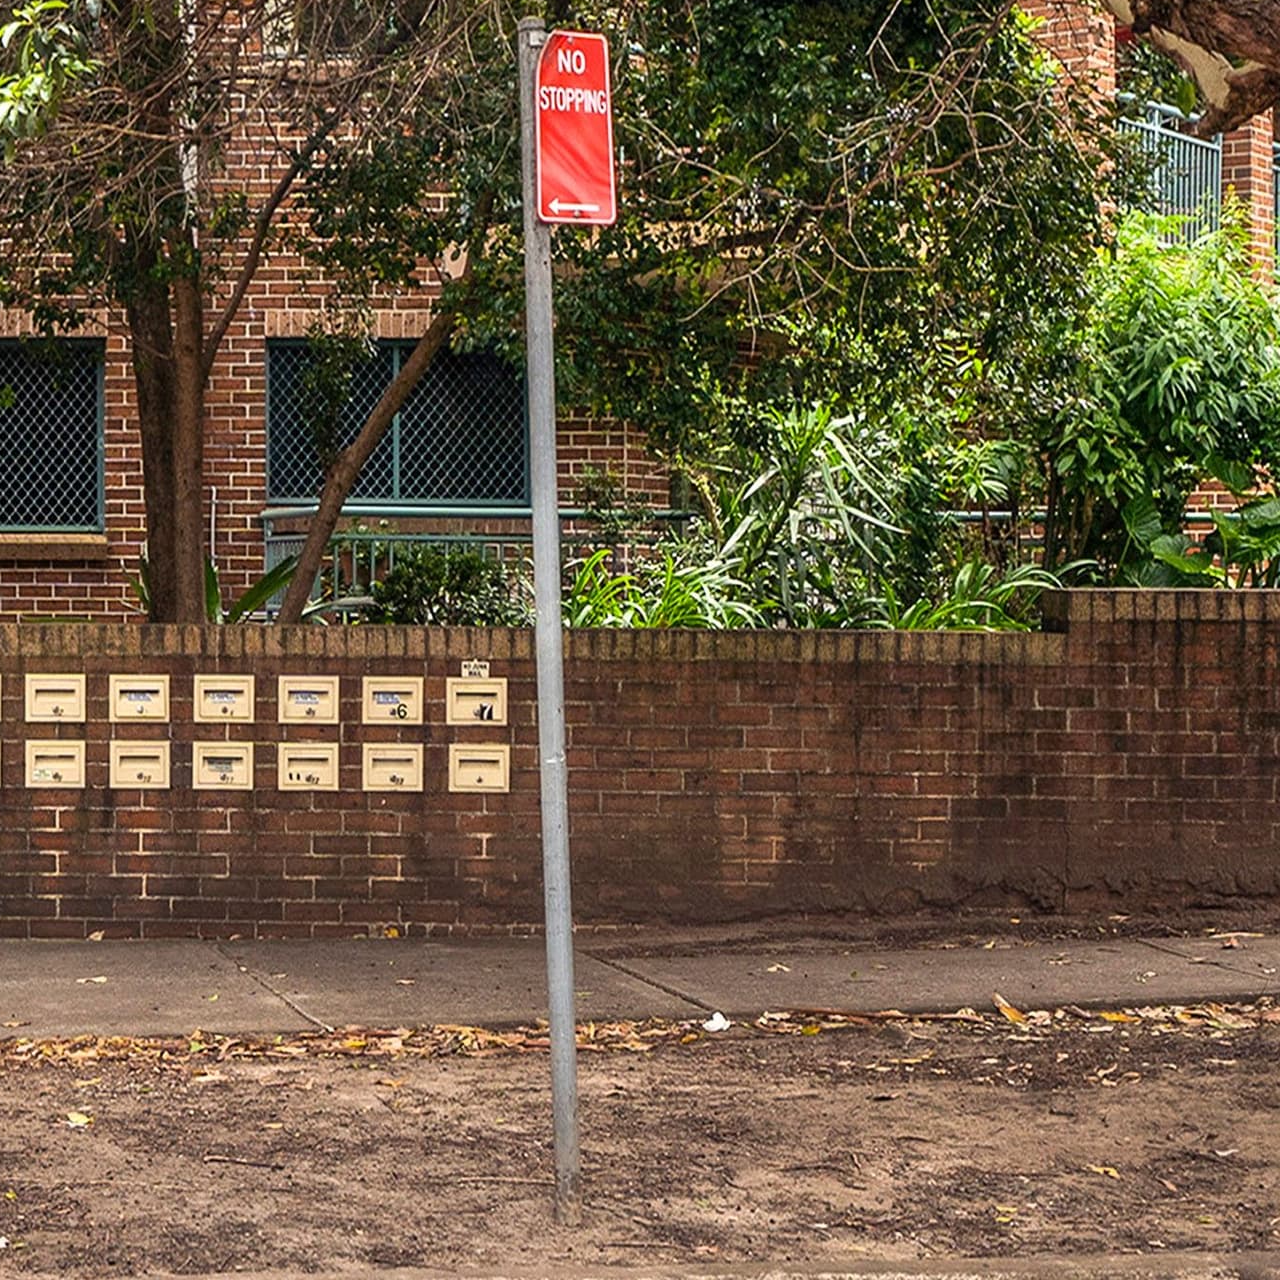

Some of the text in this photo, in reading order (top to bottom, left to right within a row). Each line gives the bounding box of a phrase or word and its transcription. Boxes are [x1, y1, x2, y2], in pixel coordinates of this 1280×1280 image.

[557, 49, 586, 75] NO
[540, 86, 607, 115] STOPPING
[397, 703, 408, 719] 6
[482, 703, 491, 720] 7
